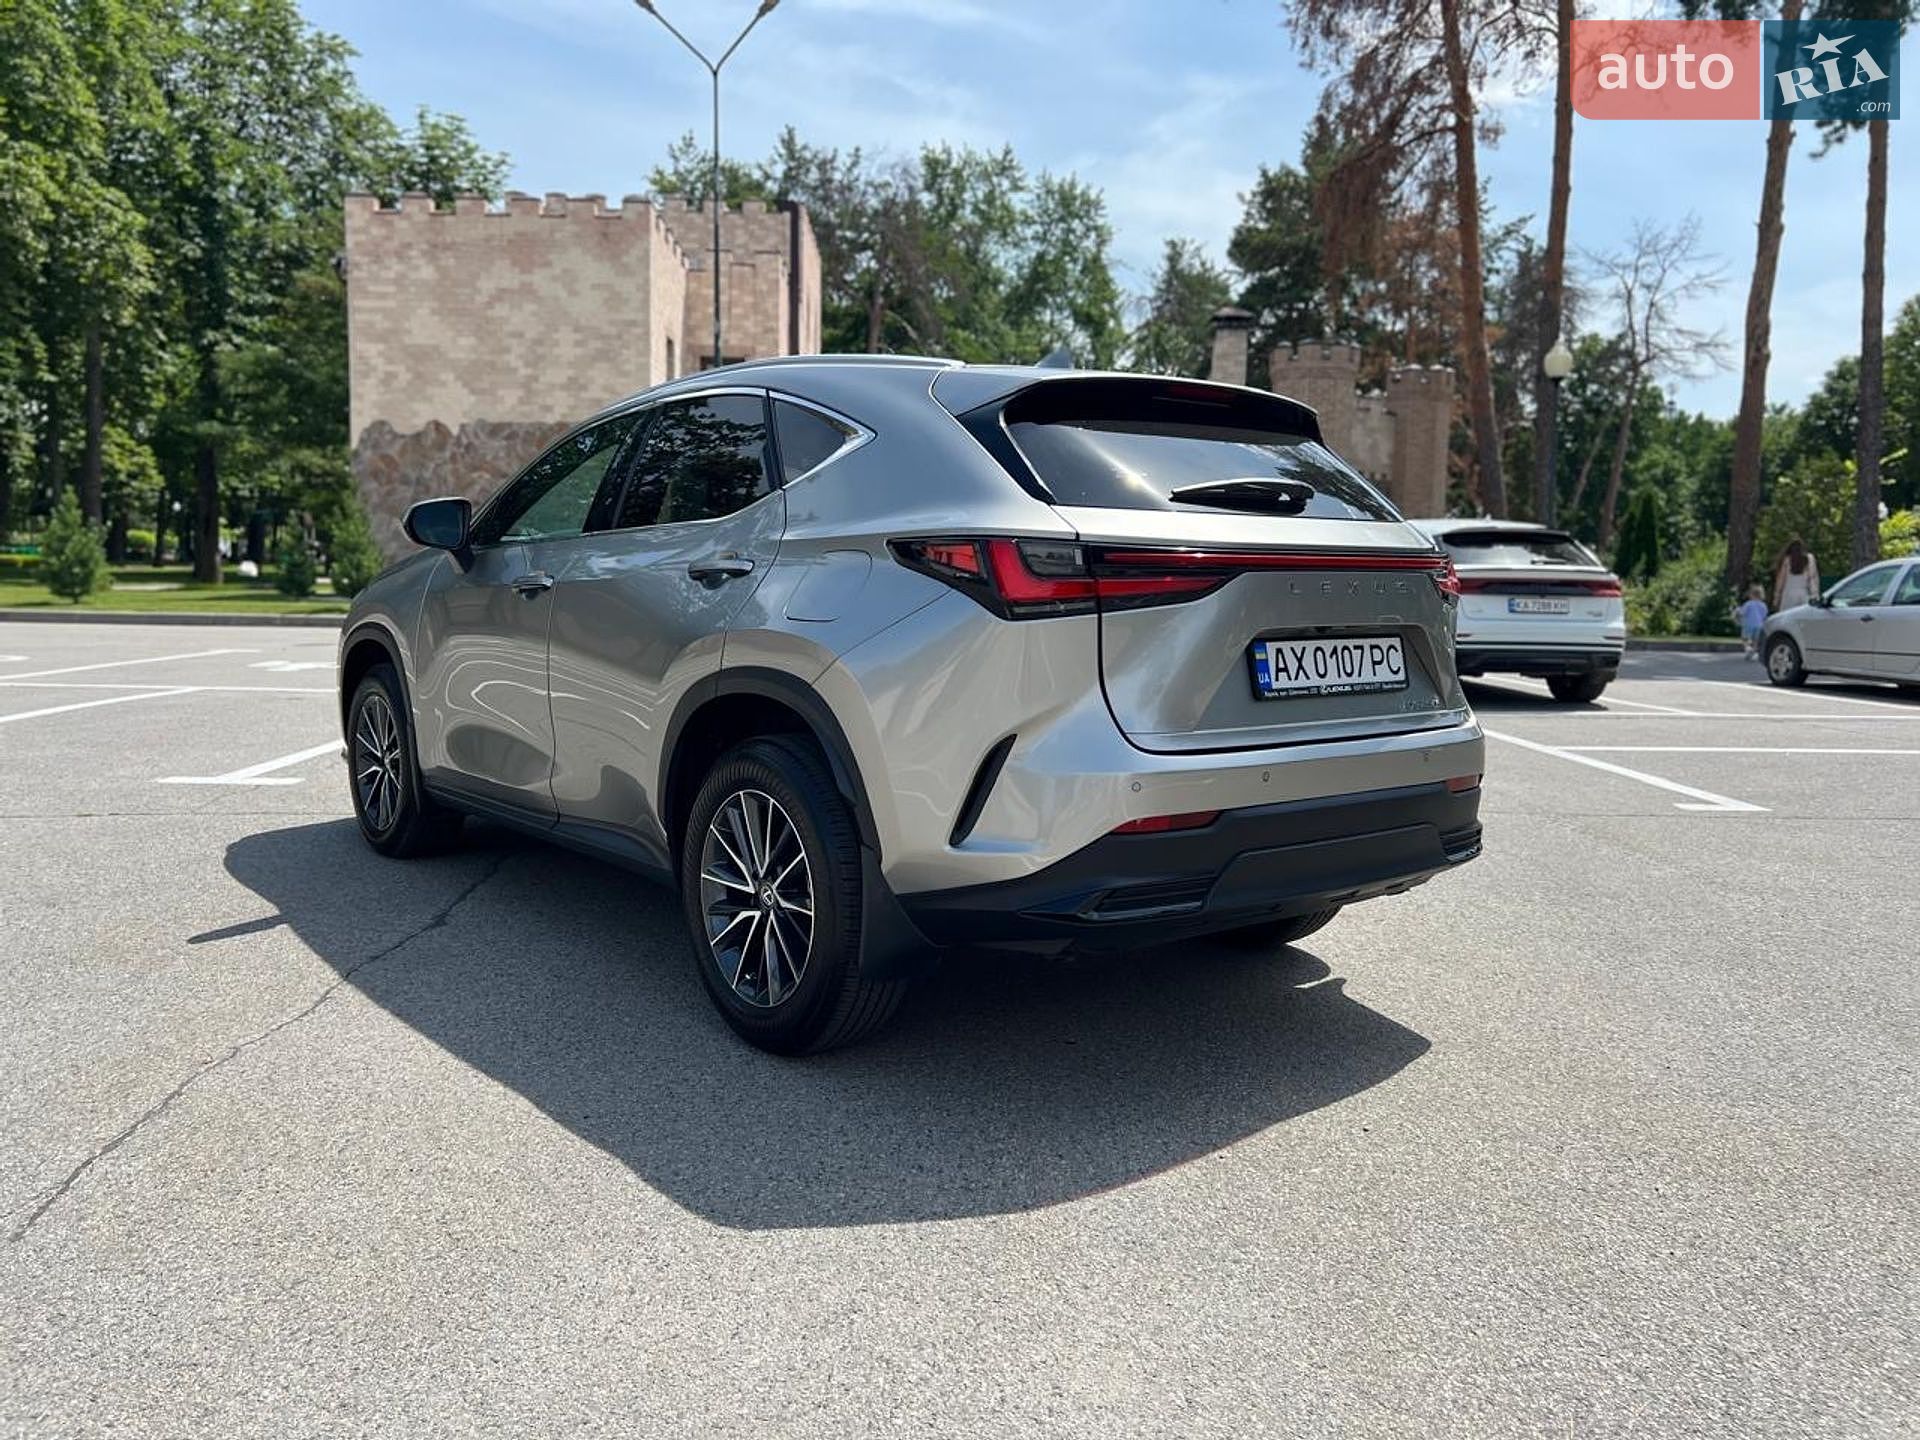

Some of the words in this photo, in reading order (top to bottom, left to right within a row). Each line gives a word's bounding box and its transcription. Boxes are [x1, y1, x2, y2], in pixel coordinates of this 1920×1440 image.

[1289, 578, 1411, 595] LEXUS
[1274, 647, 1311, 682] AX
[1313, 645, 1365, 679] 0107
[1370, 644, 1401, 676] PC
[1258, 672, 1270, 684] UA
